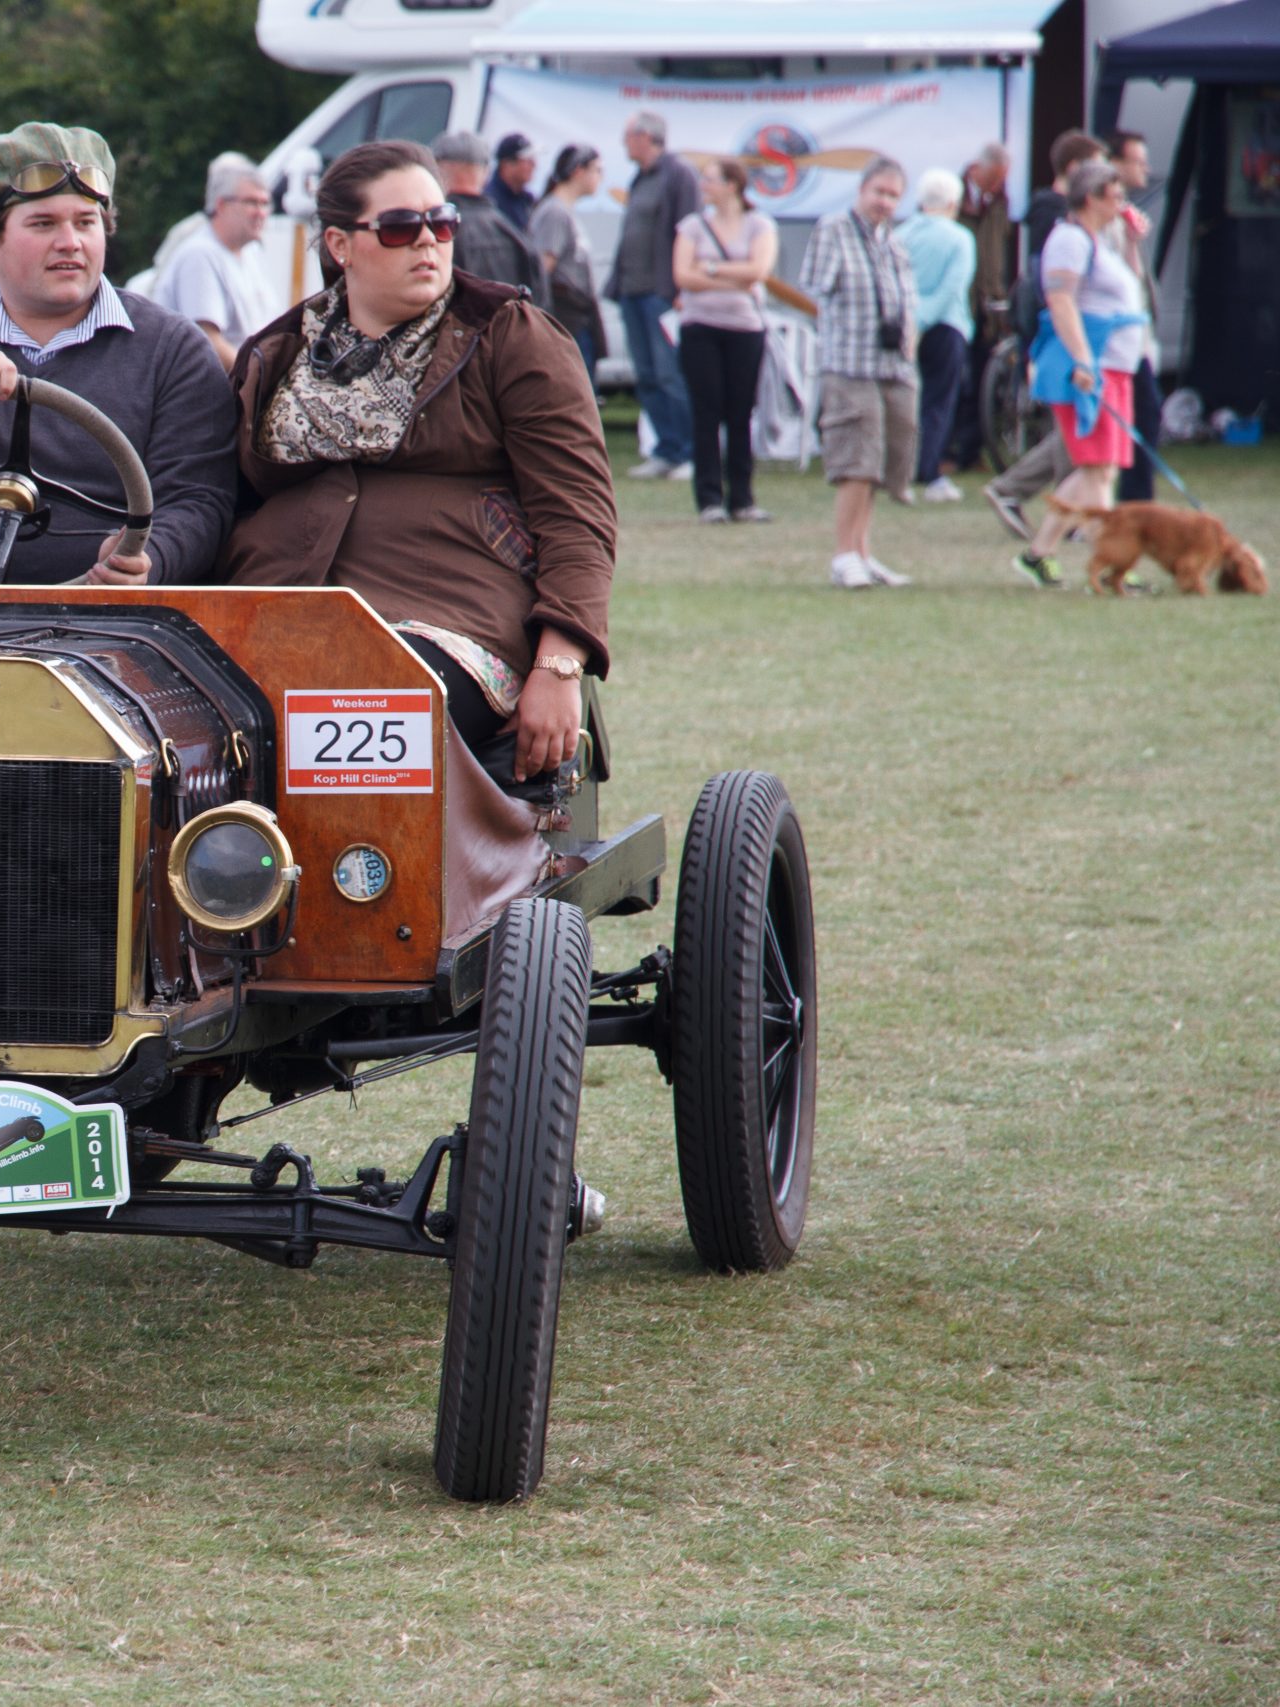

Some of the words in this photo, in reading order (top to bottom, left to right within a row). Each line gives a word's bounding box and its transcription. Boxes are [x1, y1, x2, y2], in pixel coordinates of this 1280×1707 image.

[331, 698, 388, 709] Weekend
[314, 719, 407, 763] 225
[313, 774, 338, 785] Kop
[340, 773, 360, 784] Hill
[365, 859, 382, 880] 03
[86, 1121, 106, 1190] 2014
[46, 1184, 67, 1194] ASM
